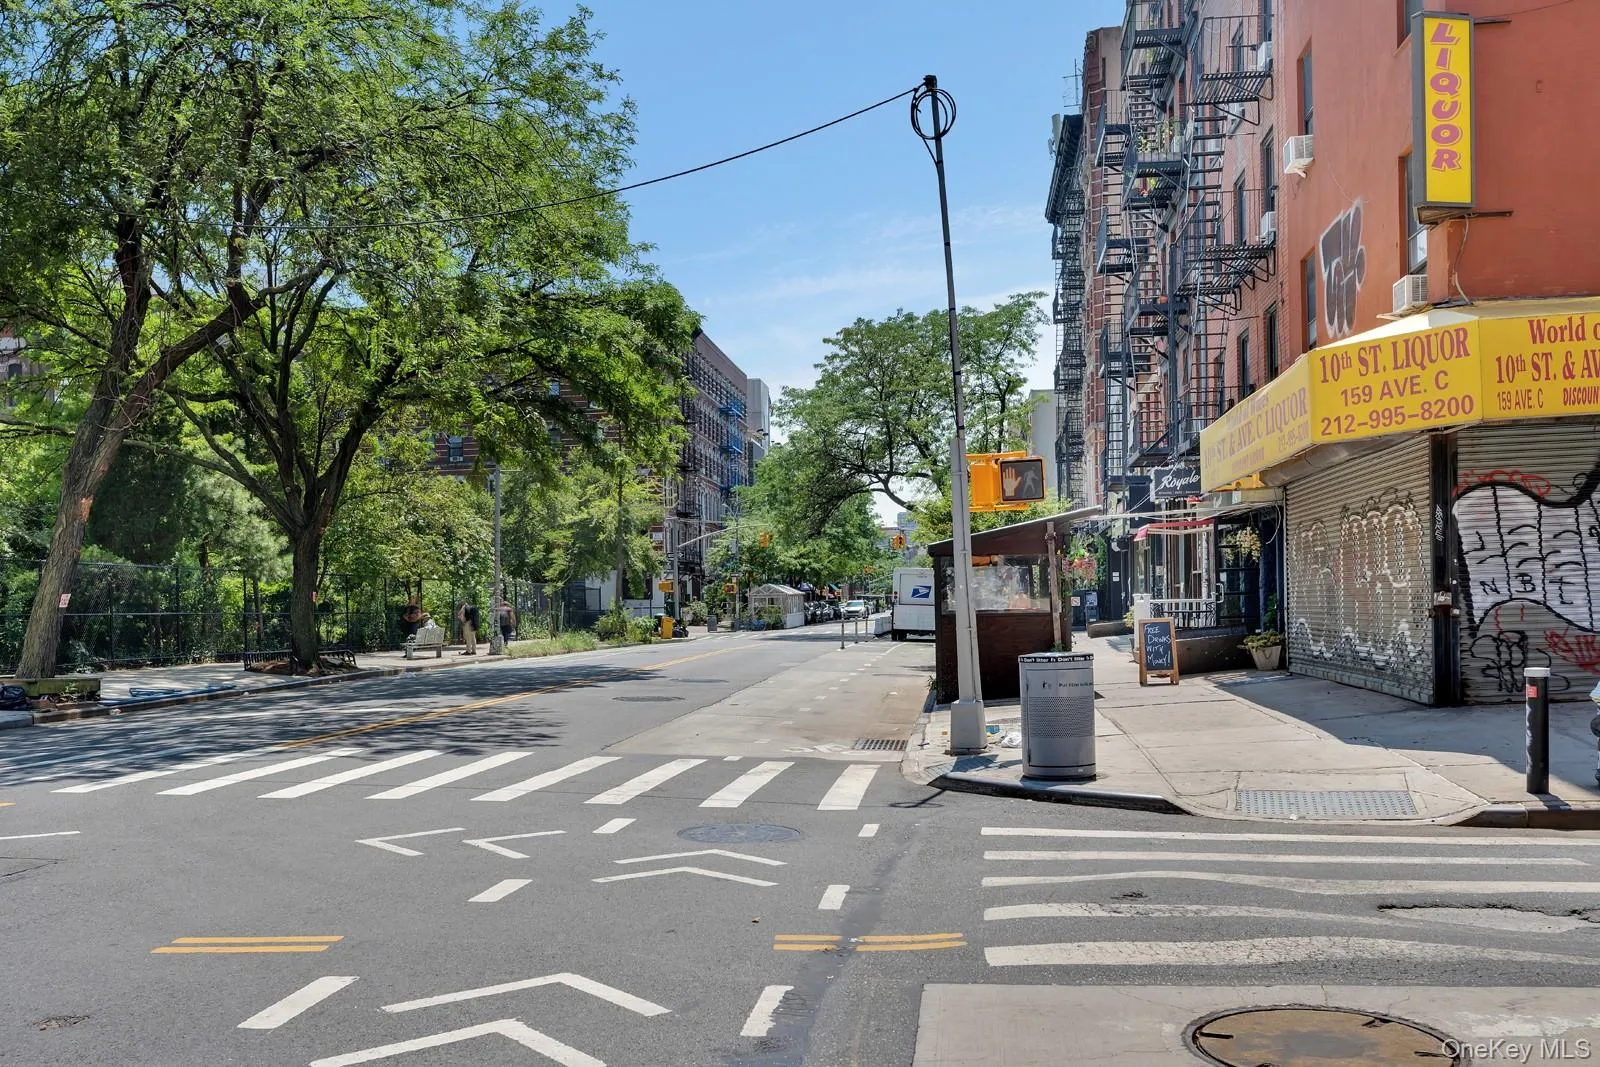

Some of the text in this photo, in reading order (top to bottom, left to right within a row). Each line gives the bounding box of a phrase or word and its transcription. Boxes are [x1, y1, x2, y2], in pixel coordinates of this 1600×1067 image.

[1430, 22, 1462, 172] LIQUOR
[1528, 315, 1586, 344] World
[1320, 327, 1470, 384] 10th ST. LIQUOR
[1495, 354, 1526, 384] 10th
[1531, 351, 1557, 382] ST.
[1562, 350, 1576, 380] &
[1341, 370, 1449, 407] 159 AVE. C
[1497, 385, 1599, 410] 159 AVE. C DISCOUN
[1256, 414, 1264, 440] C
[1265, 387, 1308, 436] LIQUOR
[1321, 394, 1474, 436] 212-995-8200
[1159, 470, 1200, 490] Royale
